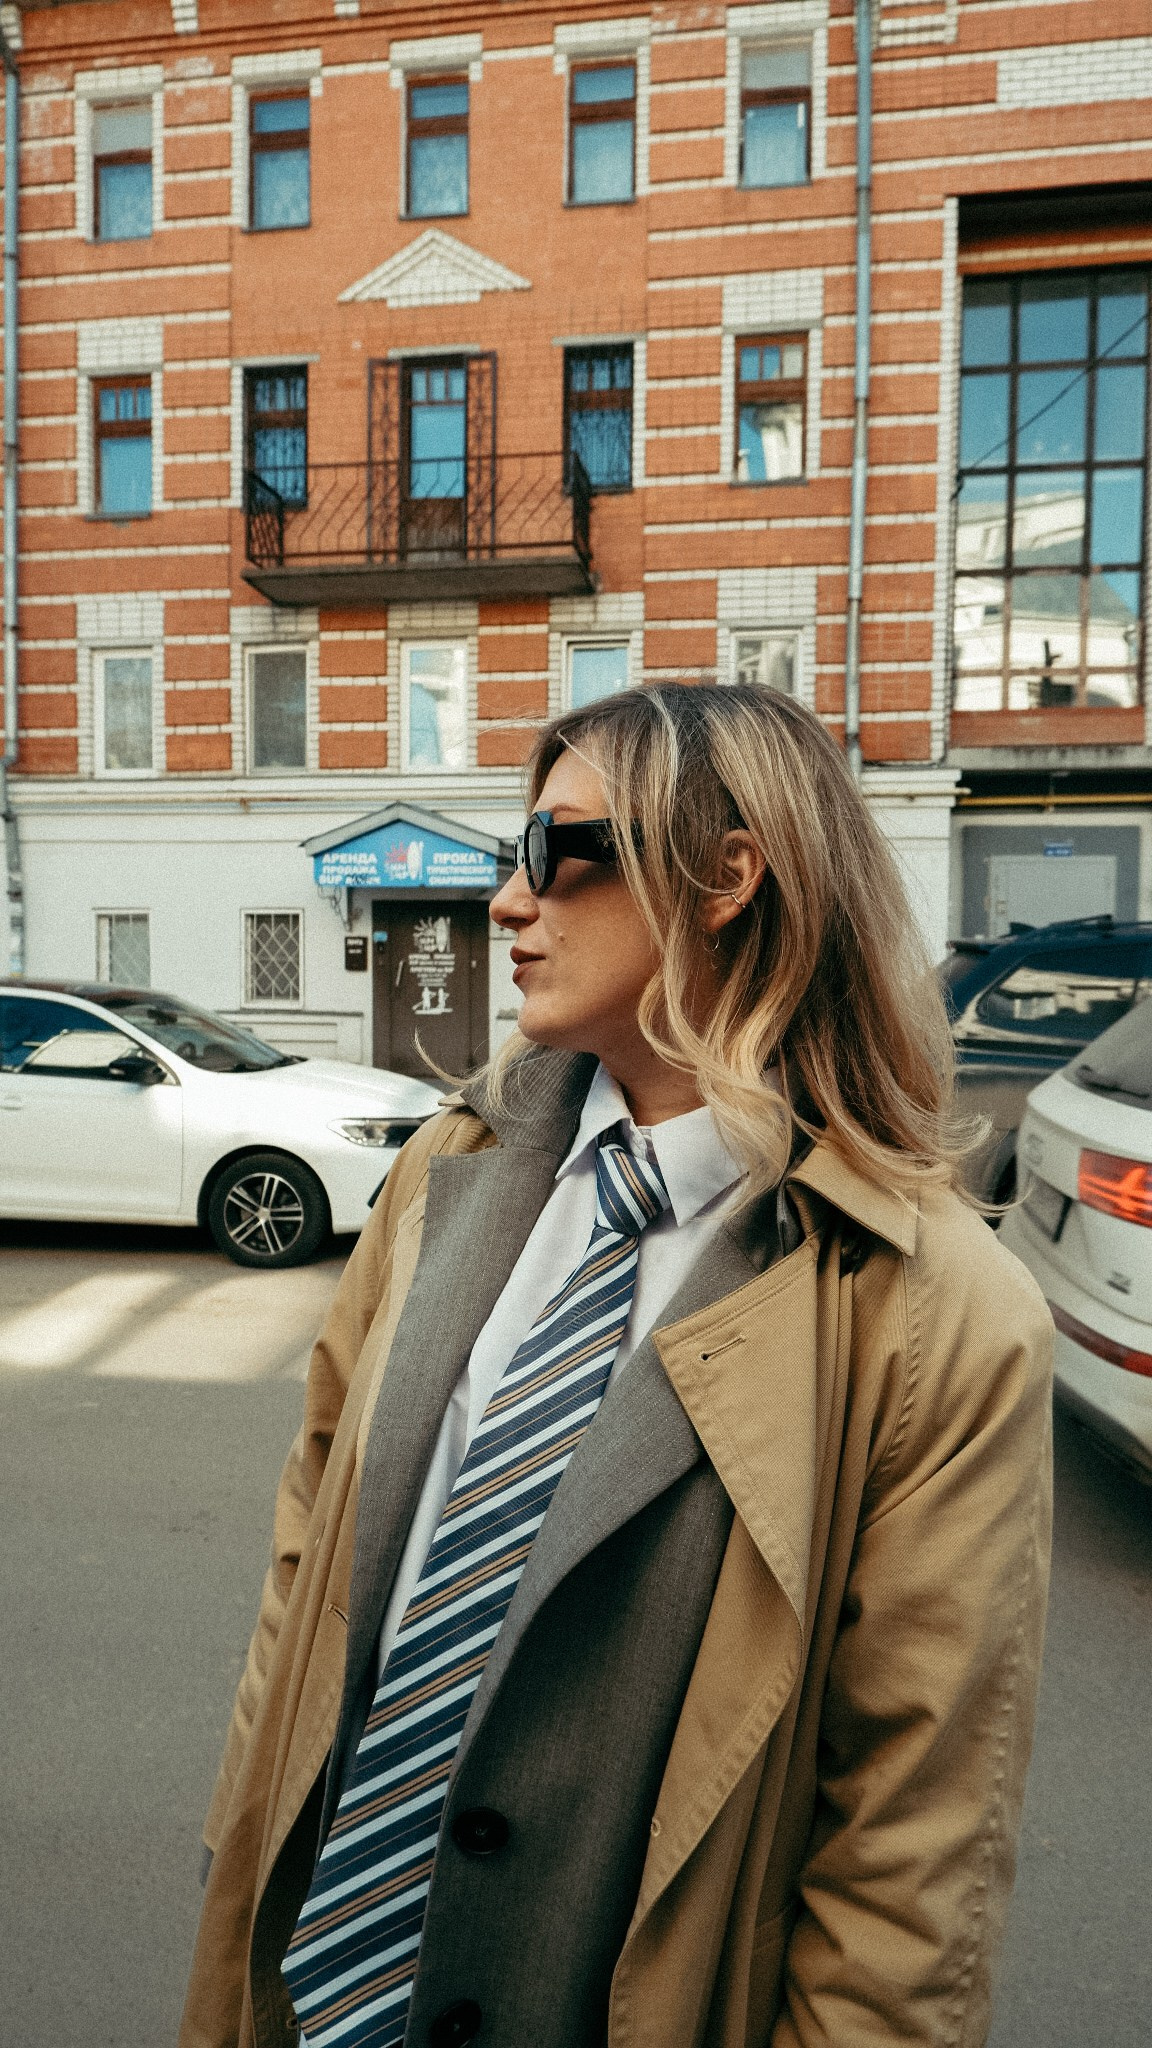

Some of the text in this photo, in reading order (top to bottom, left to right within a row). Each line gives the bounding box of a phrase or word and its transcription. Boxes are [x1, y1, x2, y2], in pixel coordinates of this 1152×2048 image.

[322, 852, 378, 865] АРЕНДА
[433, 852, 486, 865] ПРОКАТ
[322, 865, 378, 875] ПРОДАЖА
